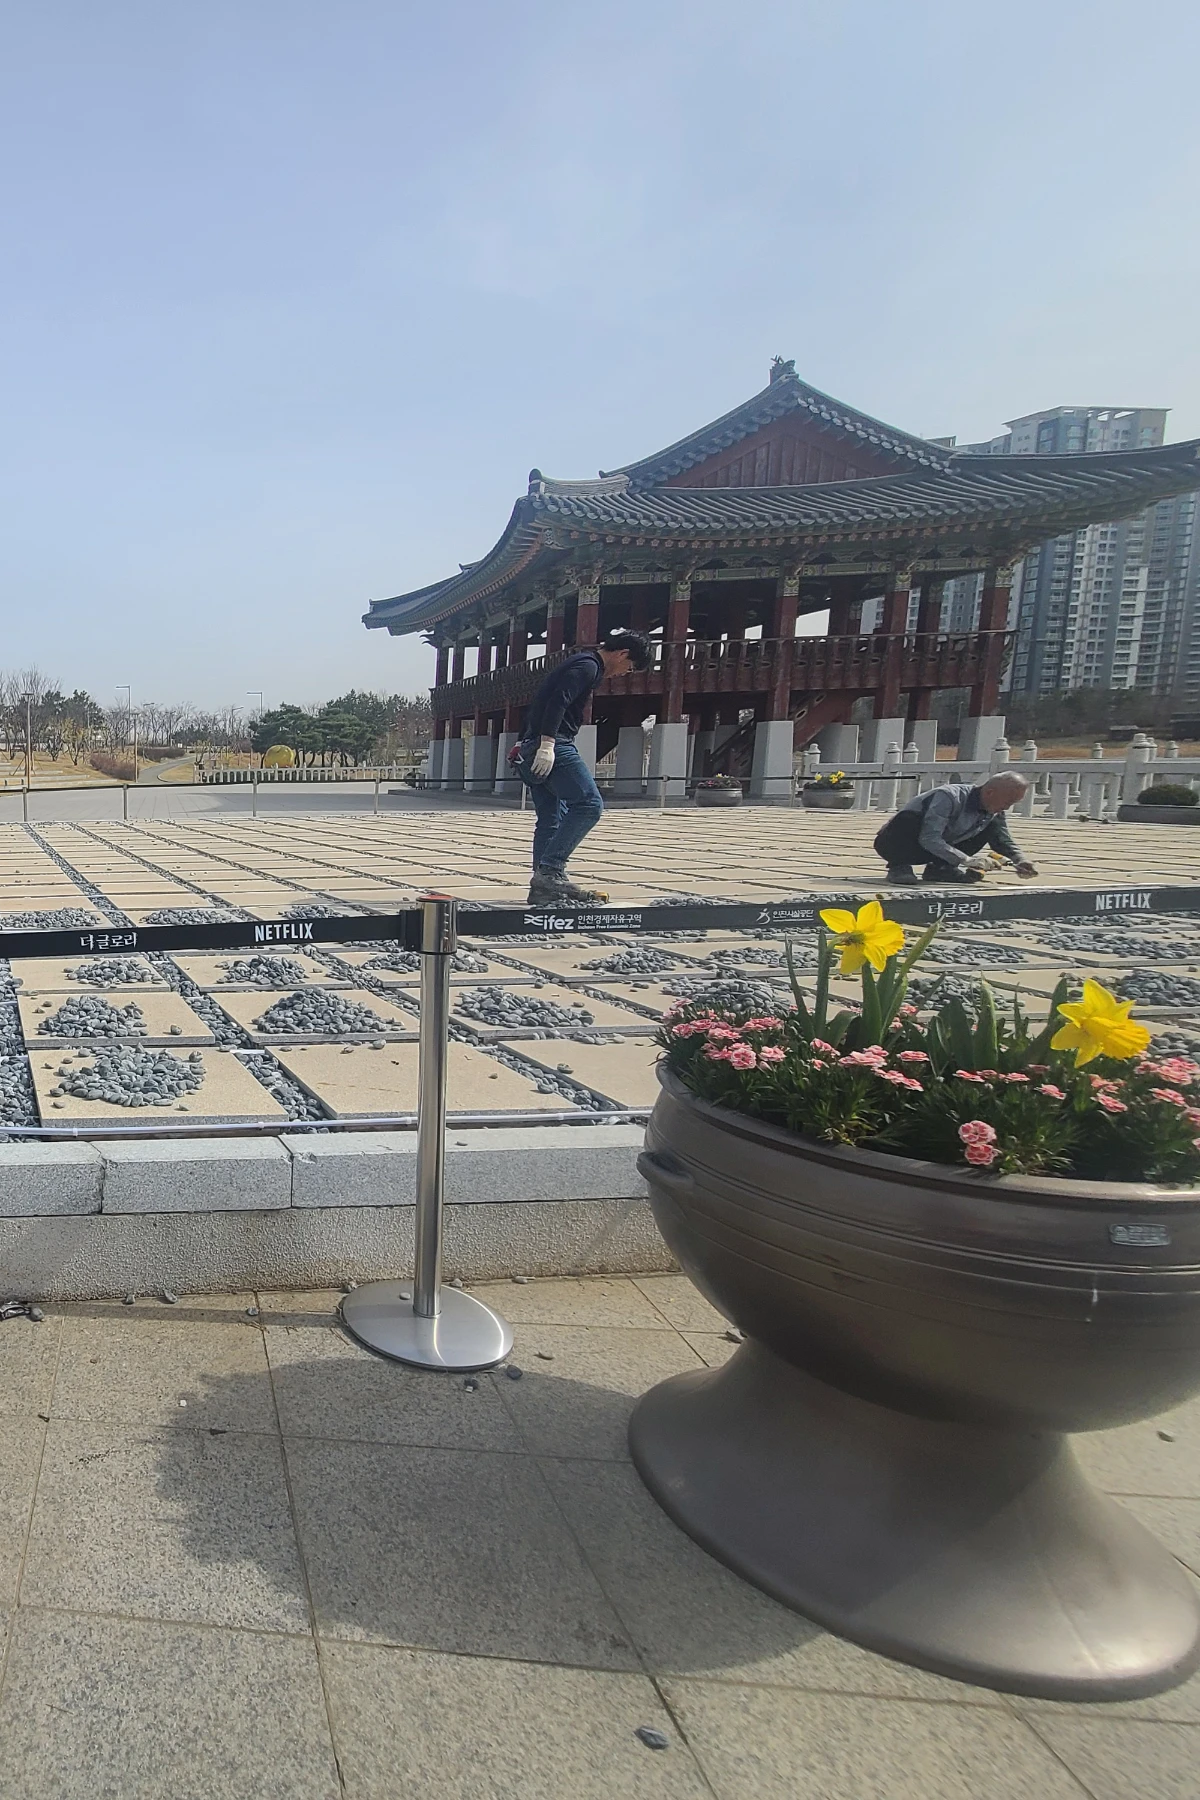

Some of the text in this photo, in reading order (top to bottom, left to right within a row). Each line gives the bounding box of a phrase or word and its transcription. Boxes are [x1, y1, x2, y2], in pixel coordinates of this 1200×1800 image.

[1095, 892, 1152, 911] NETFLIX
[543, 914, 574, 930] ifez
[577, 913, 642, 924] 인천경제자유구역
[254, 923, 314, 942] NETFLIX
